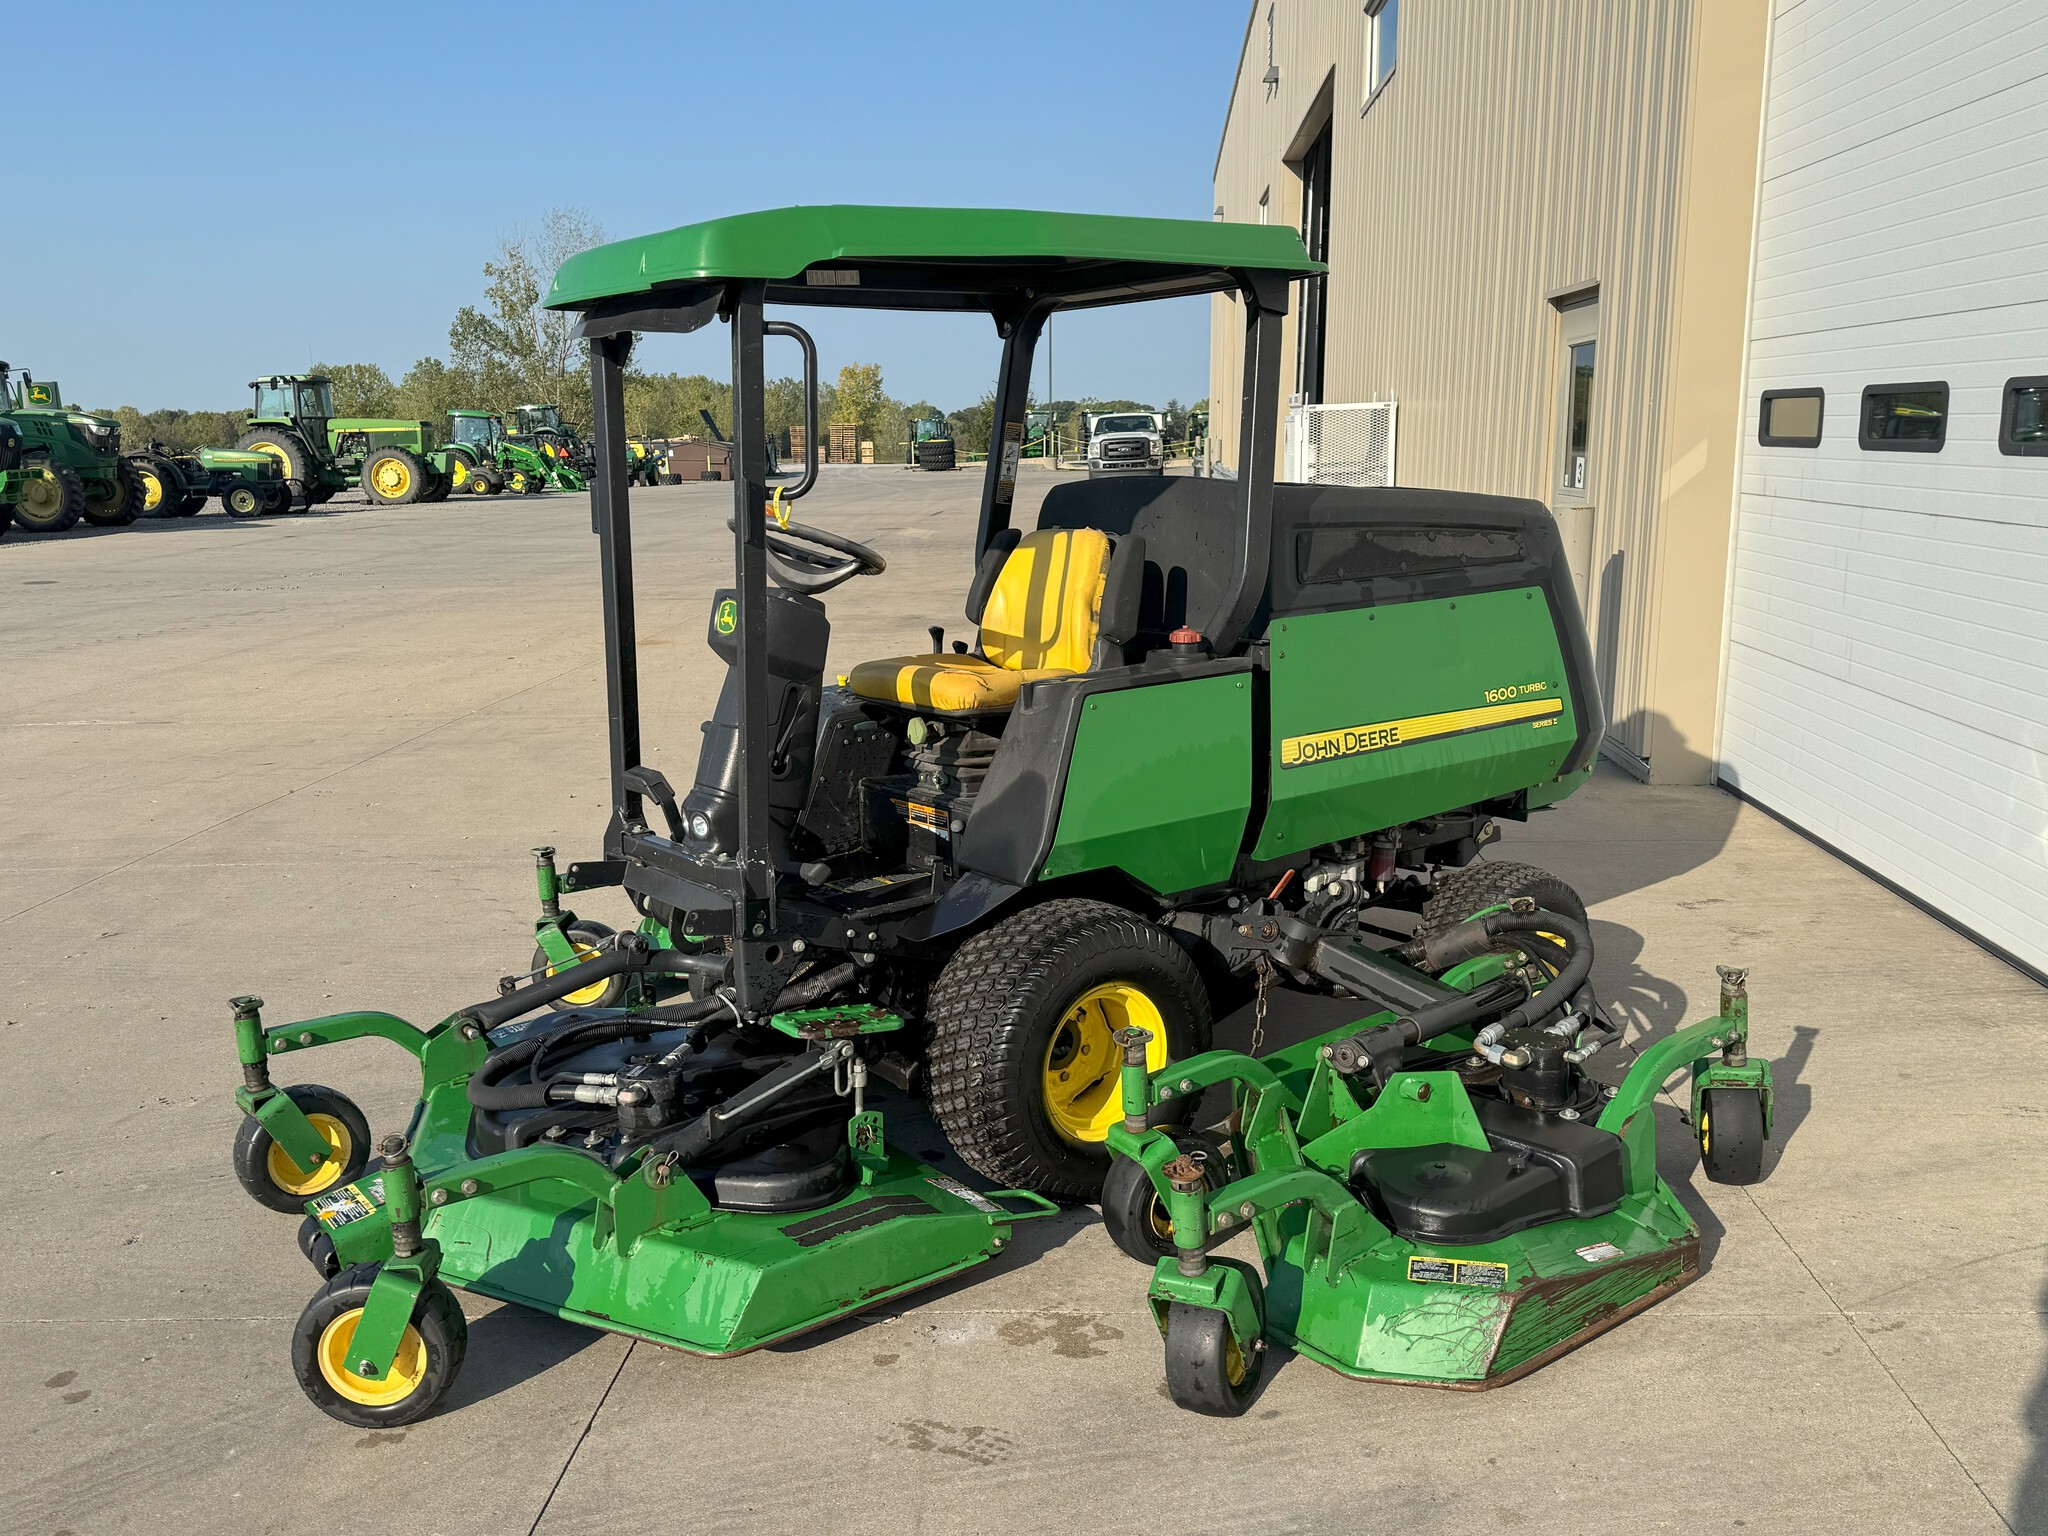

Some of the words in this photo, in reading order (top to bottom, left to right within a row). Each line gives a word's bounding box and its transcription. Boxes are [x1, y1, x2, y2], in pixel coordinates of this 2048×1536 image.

[1577, 462, 1583, 484] 3
[1484, 685, 1517, 703] 1600
[1518, 681, 1547, 695] TURBO
[1532, 719, 1552, 729] SERIES
[1292, 738, 1341, 762] JOHN
[1343, 727, 1400, 752] DEERE
